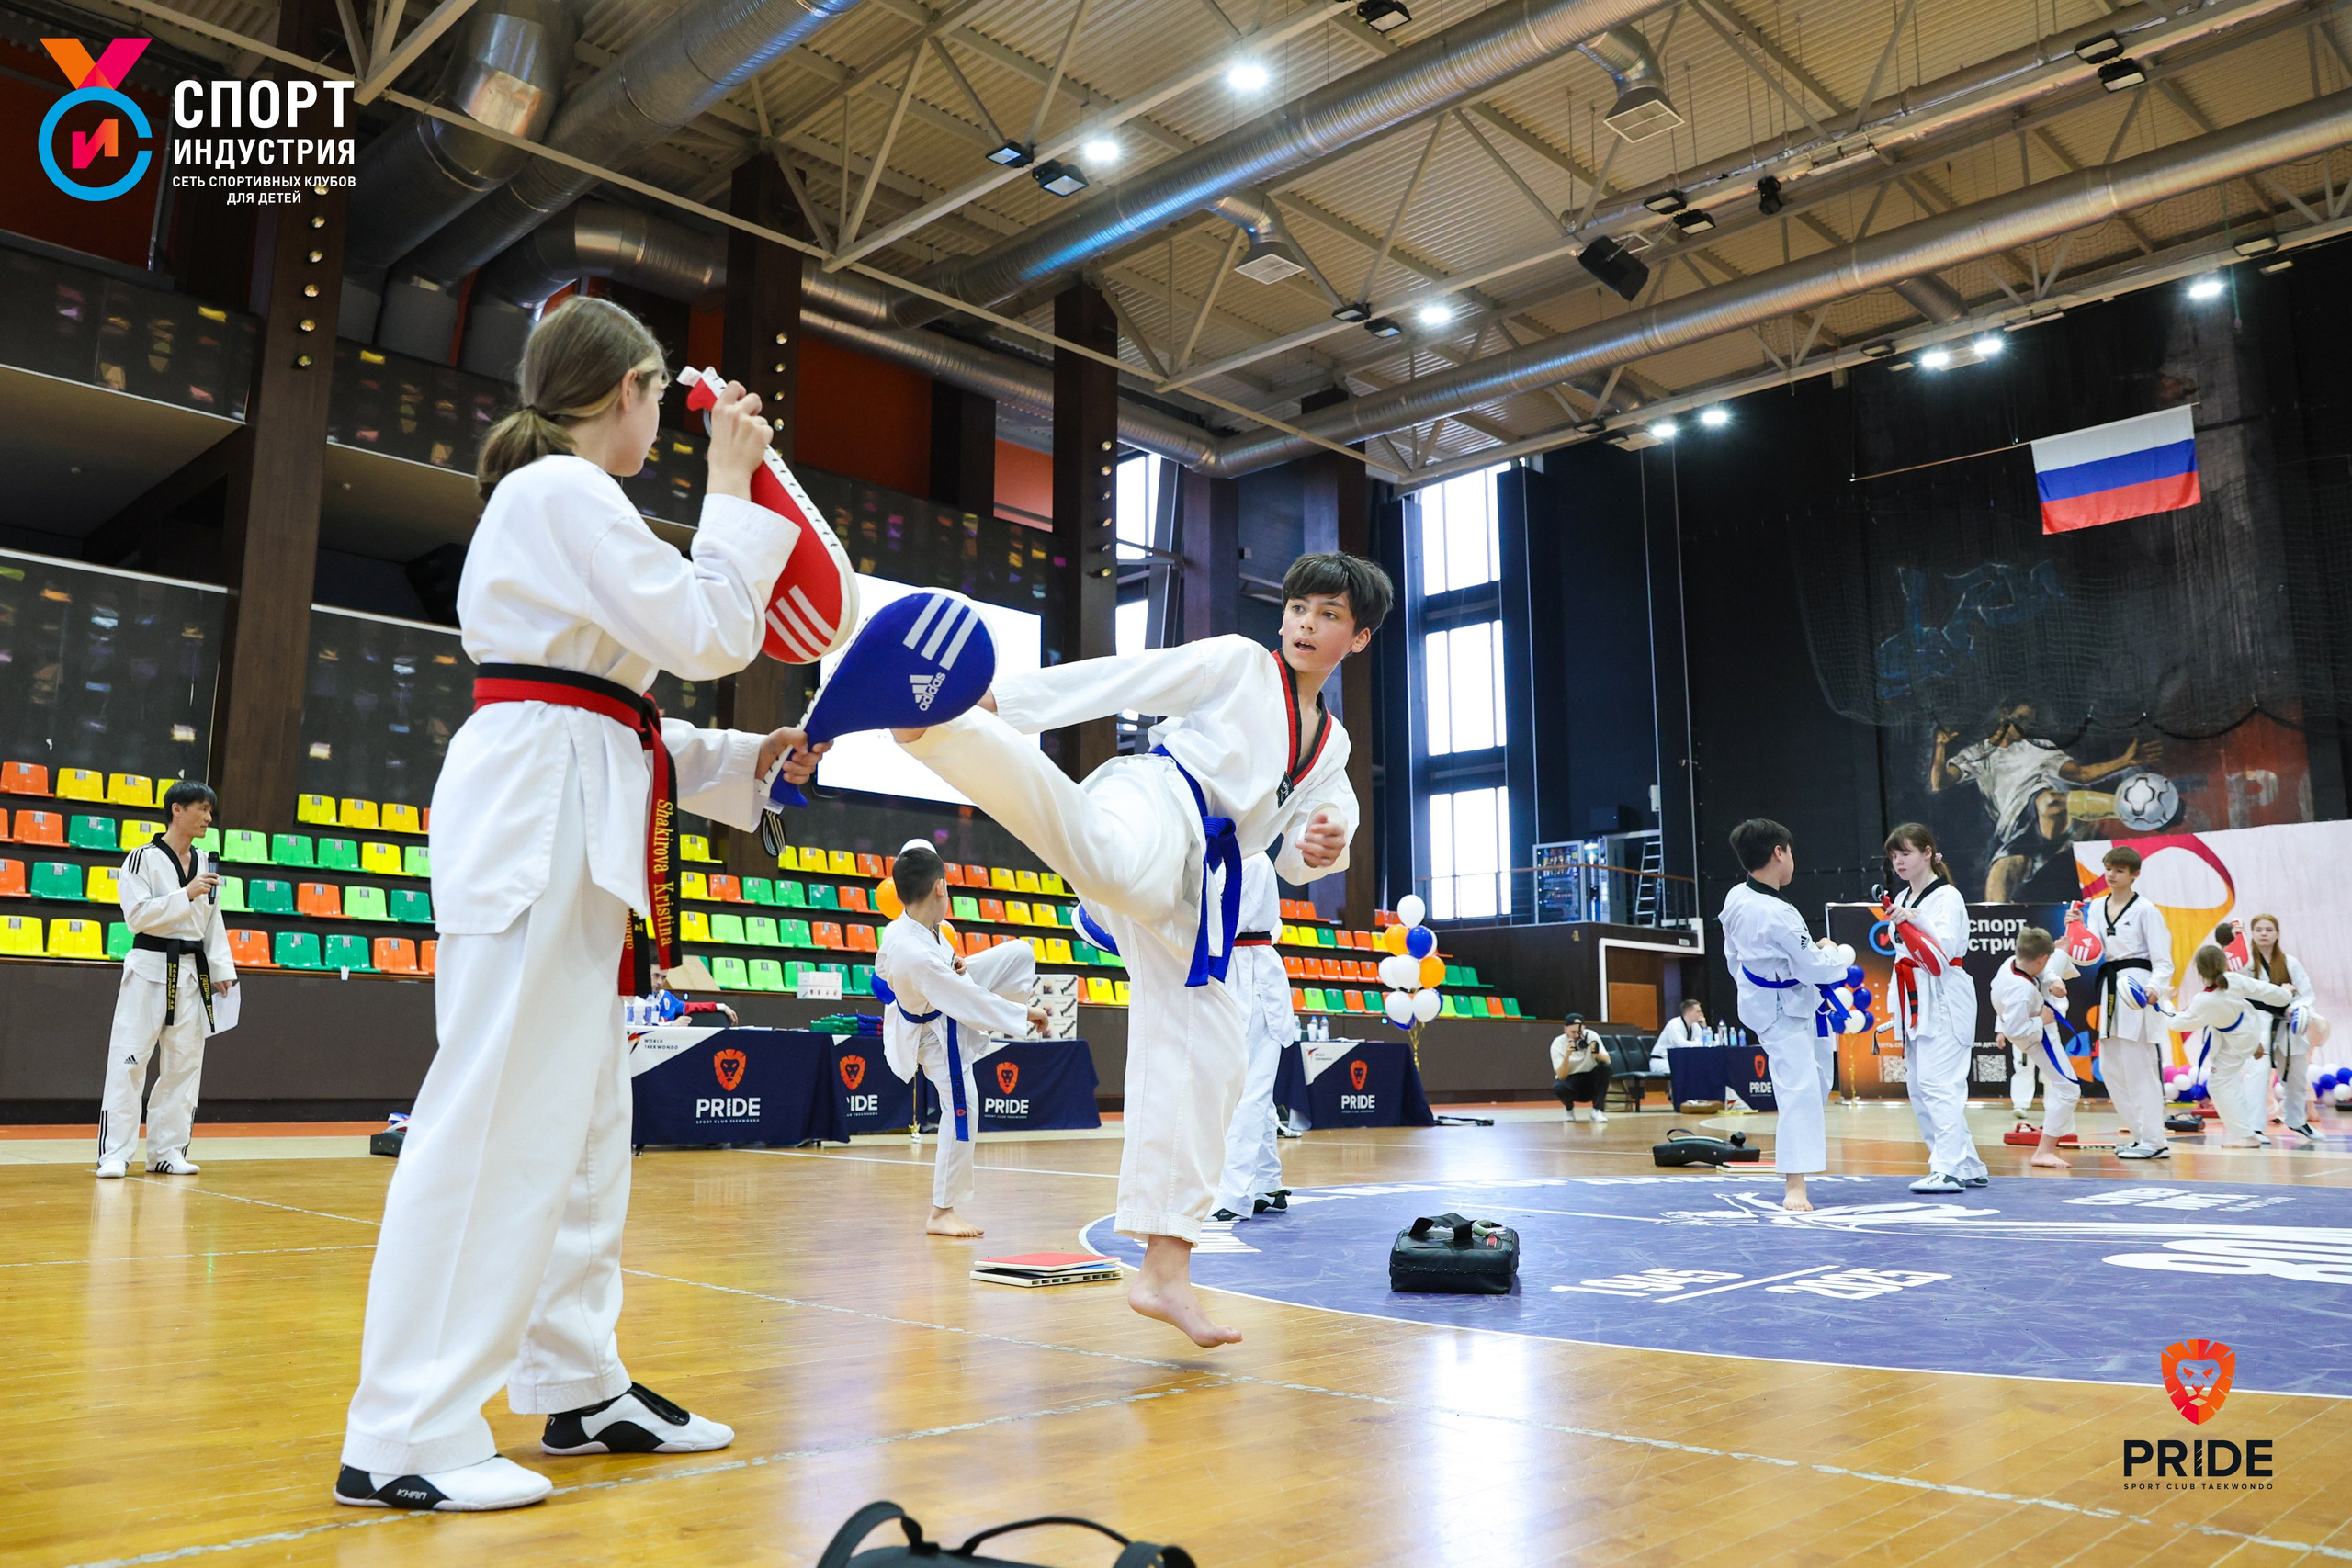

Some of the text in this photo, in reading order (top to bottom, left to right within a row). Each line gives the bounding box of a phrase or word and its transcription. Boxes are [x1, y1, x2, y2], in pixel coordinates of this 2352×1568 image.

[919, 671, 946, 711] adidas
[653, 798, 675, 947] Shakirova Kristina
[1968, 919, 2027, 937] спорт
[695, 1097, 761, 1118] PRIDE
[845, 1094, 878, 1111] IDE
[984, 1097, 1030, 1114] PRIDE
[1341, 1094, 1375, 1109] PRIDE
[1550, 1267, 1953, 1300] 1945 2025
[396, 1488, 428, 1500] KHAN
